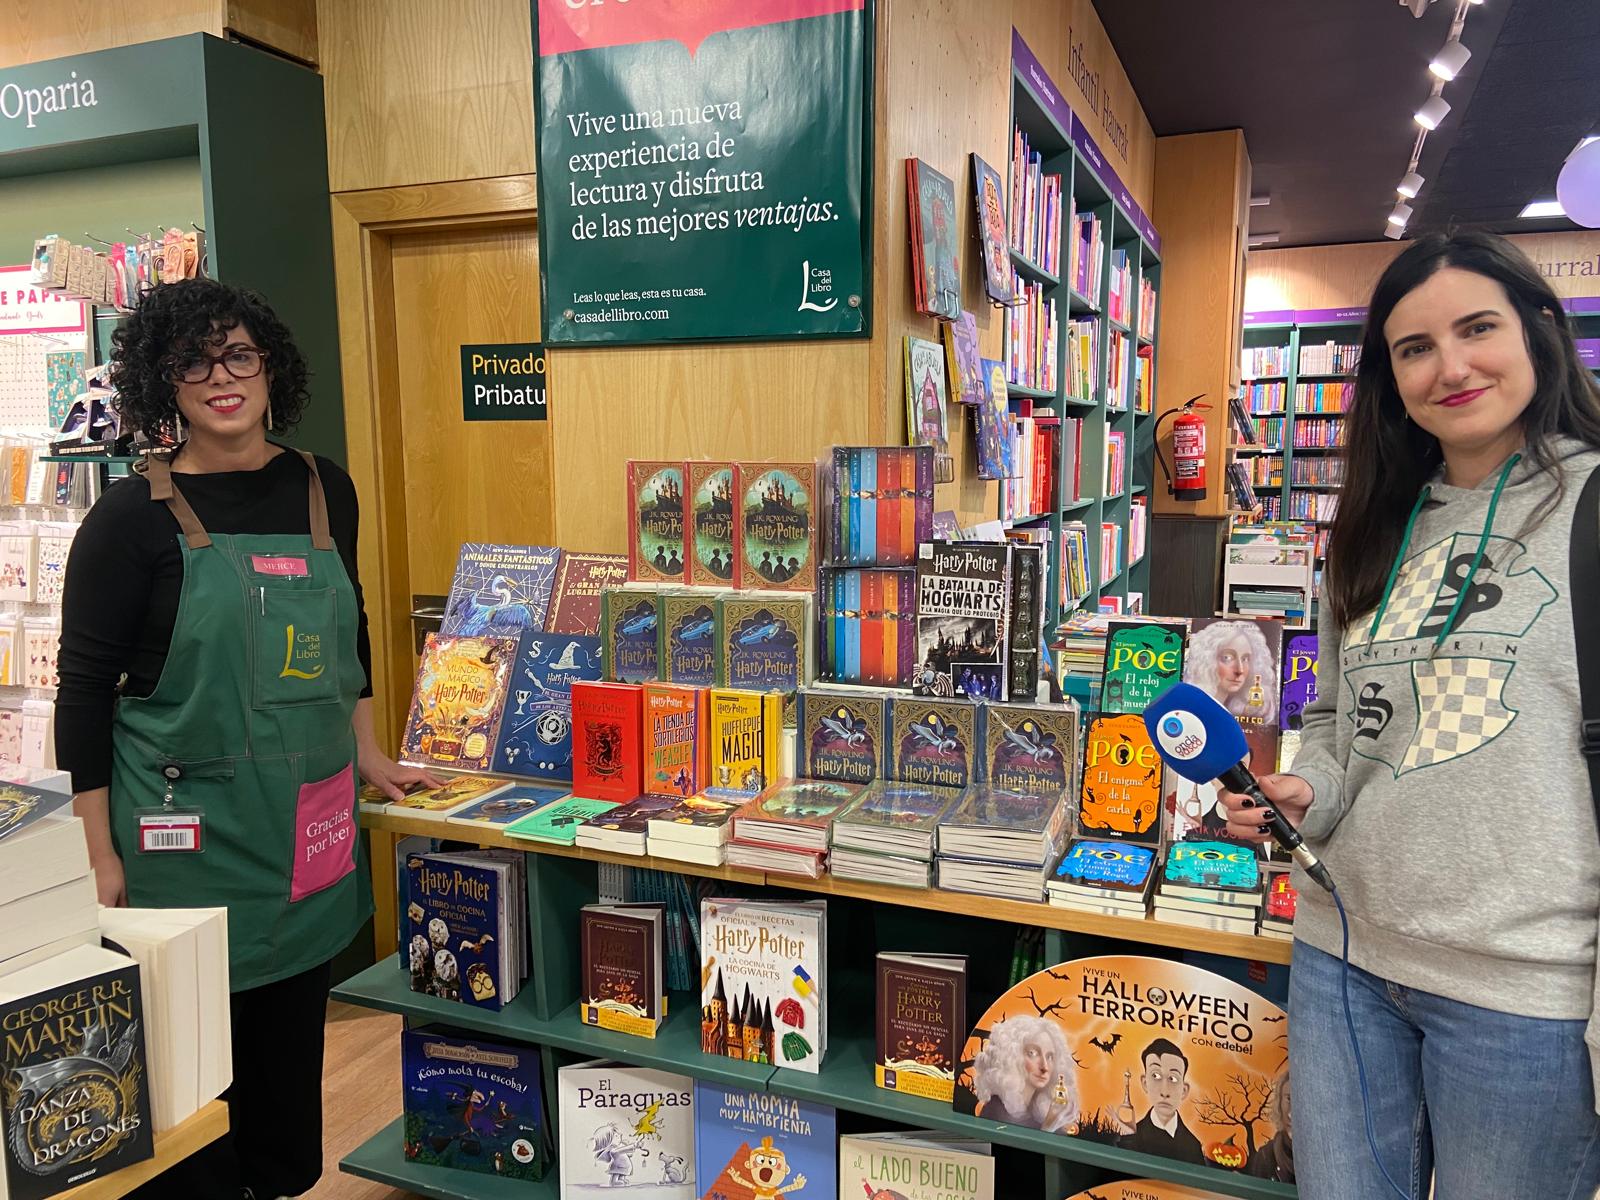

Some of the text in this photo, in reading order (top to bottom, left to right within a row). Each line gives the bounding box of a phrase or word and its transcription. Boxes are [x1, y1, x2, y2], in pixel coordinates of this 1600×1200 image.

[1066, 26, 1101, 117] Infantil
[0, 71, 98, 128] Oparia
[567, 101, 742, 137] Vive una nueva
[568, 132, 735, 178] experiencia de
[570, 168, 764, 208] lectura y disfruta
[571, 196, 839, 241] de las mejores ventajas.
[811, 268, 831, 277] Casa
[820, 276, 832, 284] del
[573, 287, 707, 304] Leas lo que leas, esta es tu casa.
[811, 283, 832, 292] Libro
[574, 308, 670, 323] casadellibro.com
[472, 352, 546, 375] Privado
[474, 384, 546, 405] Pribatu
[646, 520, 671, 535] Harry
[765, 515, 799, 523] ROWLING
[702, 522, 728, 537] Harry
[751, 523, 805, 540] Harry Potter
[463, 553, 502, 563] ANIMALES
[933, 552, 998, 576] Harry Potter
[589, 565, 627, 580] Harry Potter
[922, 577, 1003, 595] LA BATALLA DE
[921, 590, 1001, 611] HOGWARTS
[296, 633, 321, 643] Casa
[296, 650, 321, 658] Libro
[621, 649, 646, 667] Harry
[752, 651, 786, 659] ROWLING
[1106, 647, 1180, 674] POE
[447, 664, 479, 674] MUNDO
[678, 656, 704, 672] Harry
[736, 660, 793, 678] Harry Potter
[1125, 673, 1160, 688] El reloj
[435, 683, 486, 704] Harry Potter
[1129, 686, 1152, 697] de la
[651, 696, 683, 708] Harry Potter
[717, 703, 748, 715] Harry Potter
[653, 710, 695, 732] LA TIENDA DE
[653, 726, 694, 748] SORTILEGIOS
[1174, 734, 1198, 754] onda
[831, 750, 865, 760] ROWLING
[1084, 740, 1156, 770] POE
[1178, 737, 1203, 757] vasca
[815, 757, 872, 777] Harry Potter
[922, 757, 956, 767] ROWLING
[1015, 766, 1053, 776] ROWLING
[903, 764, 963, 786] Harry Potter
[1098, 771, 1144, 787] El enigma
[1109, 788, 1131, 801] de la
[1106, 803, 1131, 815] carta
[306, 808, 350, 838] Gracias
[307, 826, 350, 862] por leer
[1073, 848, 1148, 866] POE
[1175, 848, 1251, 865] POE
[418, 868, 490, 903] Harry Potter
[428, 898, 487, 917] LIBRO COCINA
[440, 910, 468, 922] OFICIAL
[720, 916, 749, 926] OFICIAL
[761, 915, 795, 926] RECETAS
[712, 925, 757, 955] Harry
[758, 926, 805, 960] Potter
[726, 964, 780, 981] HOGWARTS
[738, 959, 766, 969] COCINA
[767, 963, 777, 971] DE
[1107, 971, 1120, 980] UN
[3, 979, 132, 1032] GEORGE R.R.
[898, 991, 941, 1010] HARRY
[897, 1003, 943, 1024] POTTER
[5, 996, 133, 1063] MARTIN
[1191, 1037, 1253, 1056] CON edebé!
[418, 1065, 528, 1094] ¡Cómo mola tu escoba!
[599, 1080, 612, 1091] El
[20, 1087, 92, 1125] DANZA
[577, 1087, 691, 1112] Paraguas
[724, 1092, 746, 1108] UNA
[64, 1108, 92, 1131] DE
[719, 1107, 741, 1120] MUY
[33, 1113, 142, 1166] DRAGONES
[853, 1153, 979, 1194] el LADO BUENO
